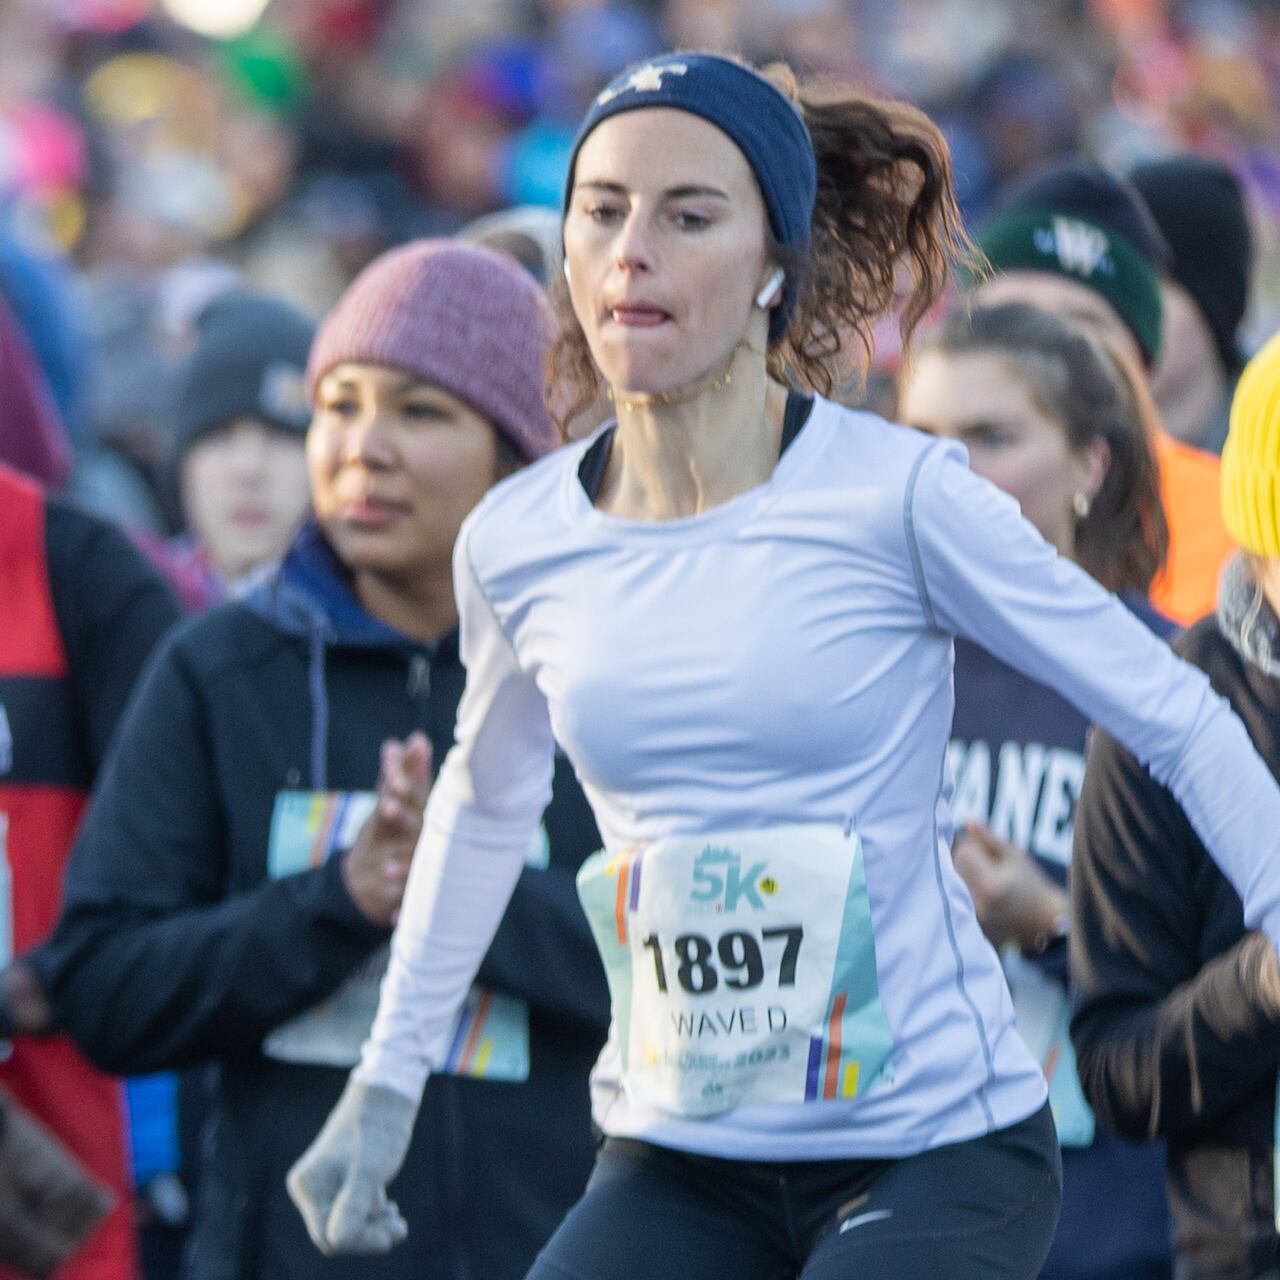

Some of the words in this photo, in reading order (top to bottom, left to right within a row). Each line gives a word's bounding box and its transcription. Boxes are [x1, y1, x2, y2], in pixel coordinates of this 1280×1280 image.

[689, 847, 769, 913] 5K
[643, 923, 804, 996] 1897
[670, 1008, 758, 1038] WAVE
[767, 1005, 788, 1034] D
